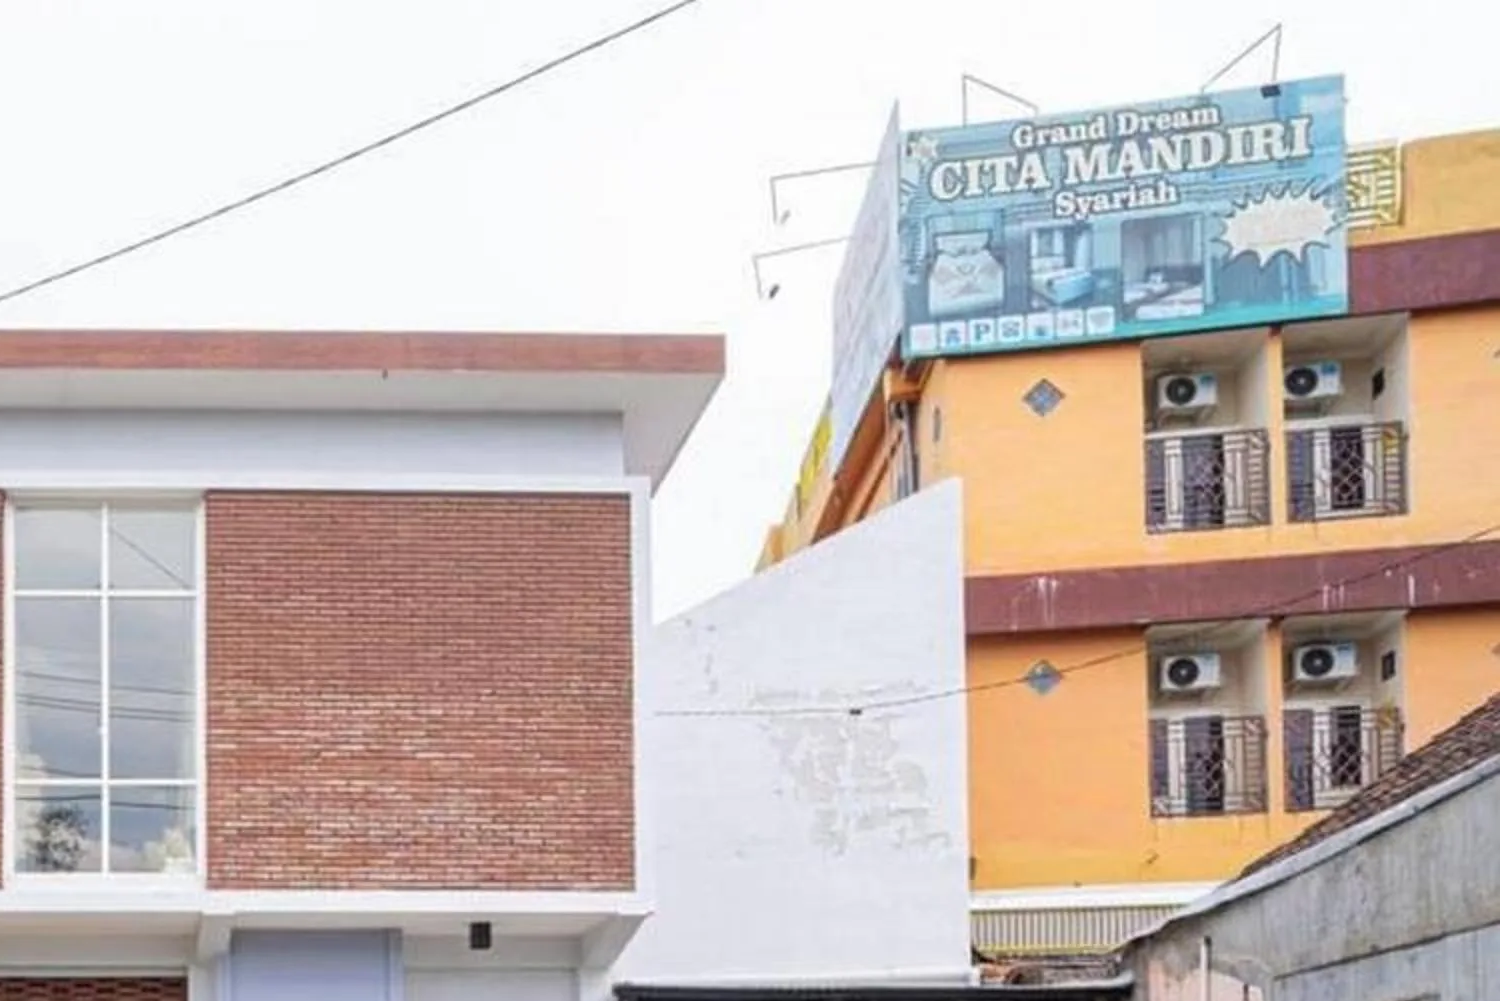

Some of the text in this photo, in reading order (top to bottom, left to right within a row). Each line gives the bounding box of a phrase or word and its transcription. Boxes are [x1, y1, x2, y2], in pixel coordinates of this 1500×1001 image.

[1012, 106, 1220, 148] Grand Dream
[930, 118, 1312, 199] CITA MANDIRI
[1054, 181, 1179, 220] Syariah
